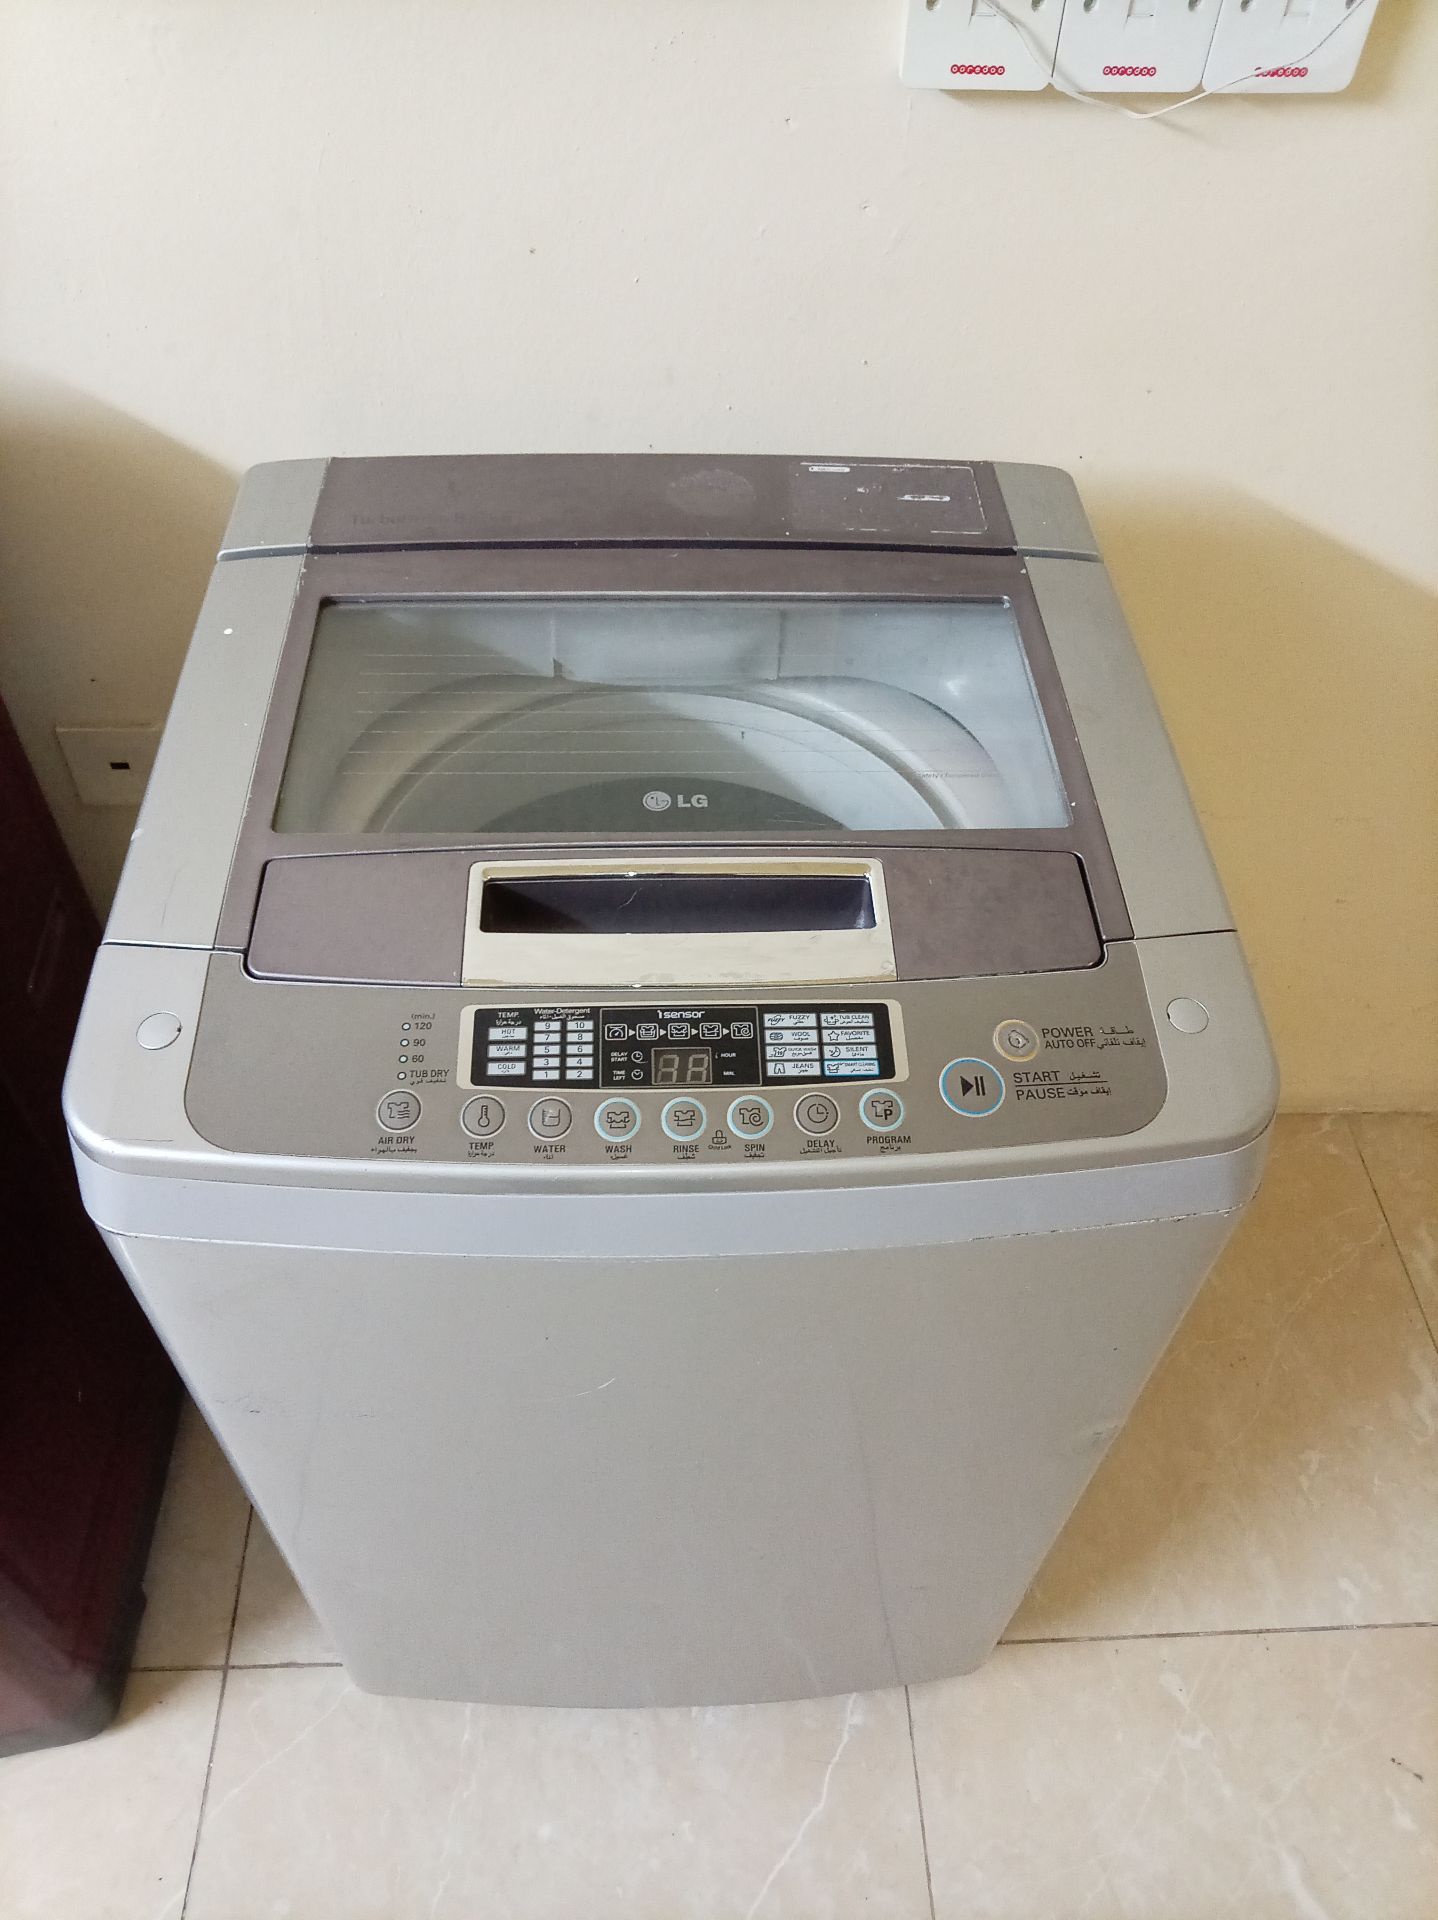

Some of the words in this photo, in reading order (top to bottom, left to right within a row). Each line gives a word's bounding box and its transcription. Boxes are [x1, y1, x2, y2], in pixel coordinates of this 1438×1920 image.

[951, 64, 1005, 75] ooredoo
[1103, 66, 1156, 76] ooredoo
[677, 794, 708, 808] LG
[414, 1022, 432, 1030] 120
[1042, 1026, 1094, 1038] POWER
[413, 1039, 426, 1047] 90
[1045, 1040, 1074, 1049] AUTO
[1077, 1038, 1096, 1048] OFF
[410, 1070, 428, 1078] TUB
[430, 1069, 450, 1078] DRY
[1013, 1071, 1060, 1083] START
[1016, 1088, 1066, 1100] PAUSE
[396, 1136, 415, 1144] DRY
[807, 1140, 834, 1148] DELAY
[866, 1136, 912, 1144] PROGRAM
[469, 1142, 494, 1150] TEMP
[534, 1145, 566, 1153] WATER
[605, 1144, 632, 1153] WASH
[672, 1145, 700, 1153] RINSE
[744, 1144, 765, 1152] SPIN
